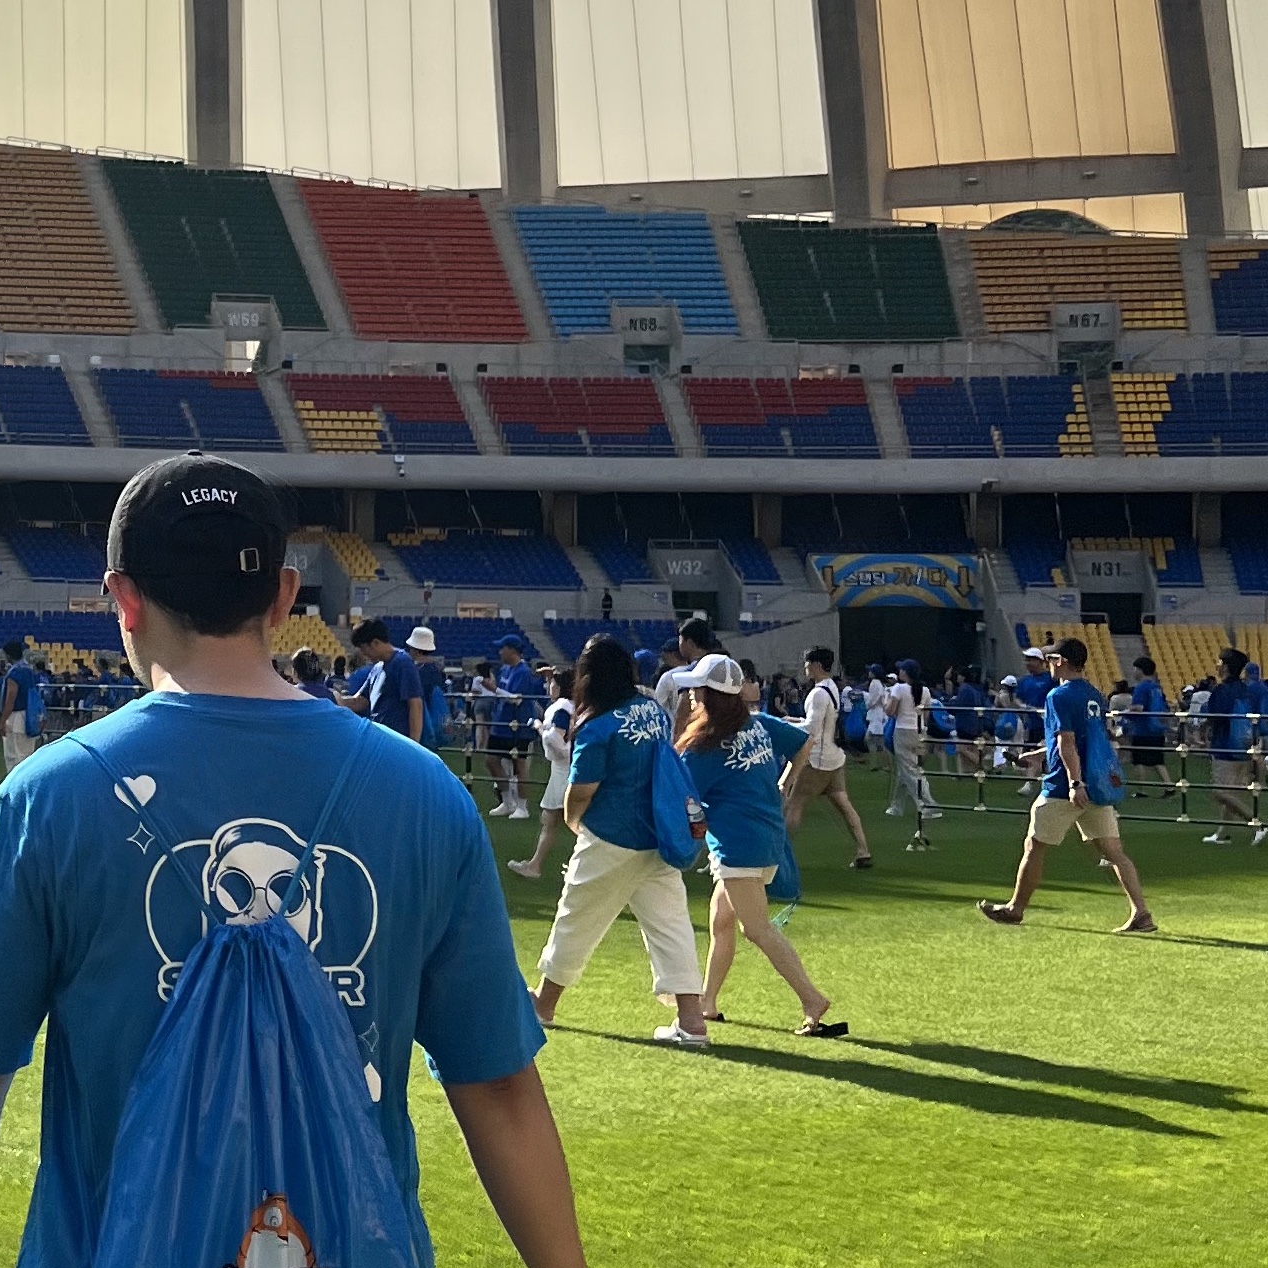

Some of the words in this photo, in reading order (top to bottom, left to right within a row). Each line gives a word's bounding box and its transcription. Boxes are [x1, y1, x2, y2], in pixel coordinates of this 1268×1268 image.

[227, 312, 259, 327] W69
[629, 317, 658, 331] N68
[1068, 313, 1101, 328] N67
[181, 487, 238, 506] LEGACY
[667, 560, 703, 575] W32
[1091, 561, 1121, 576] N31
